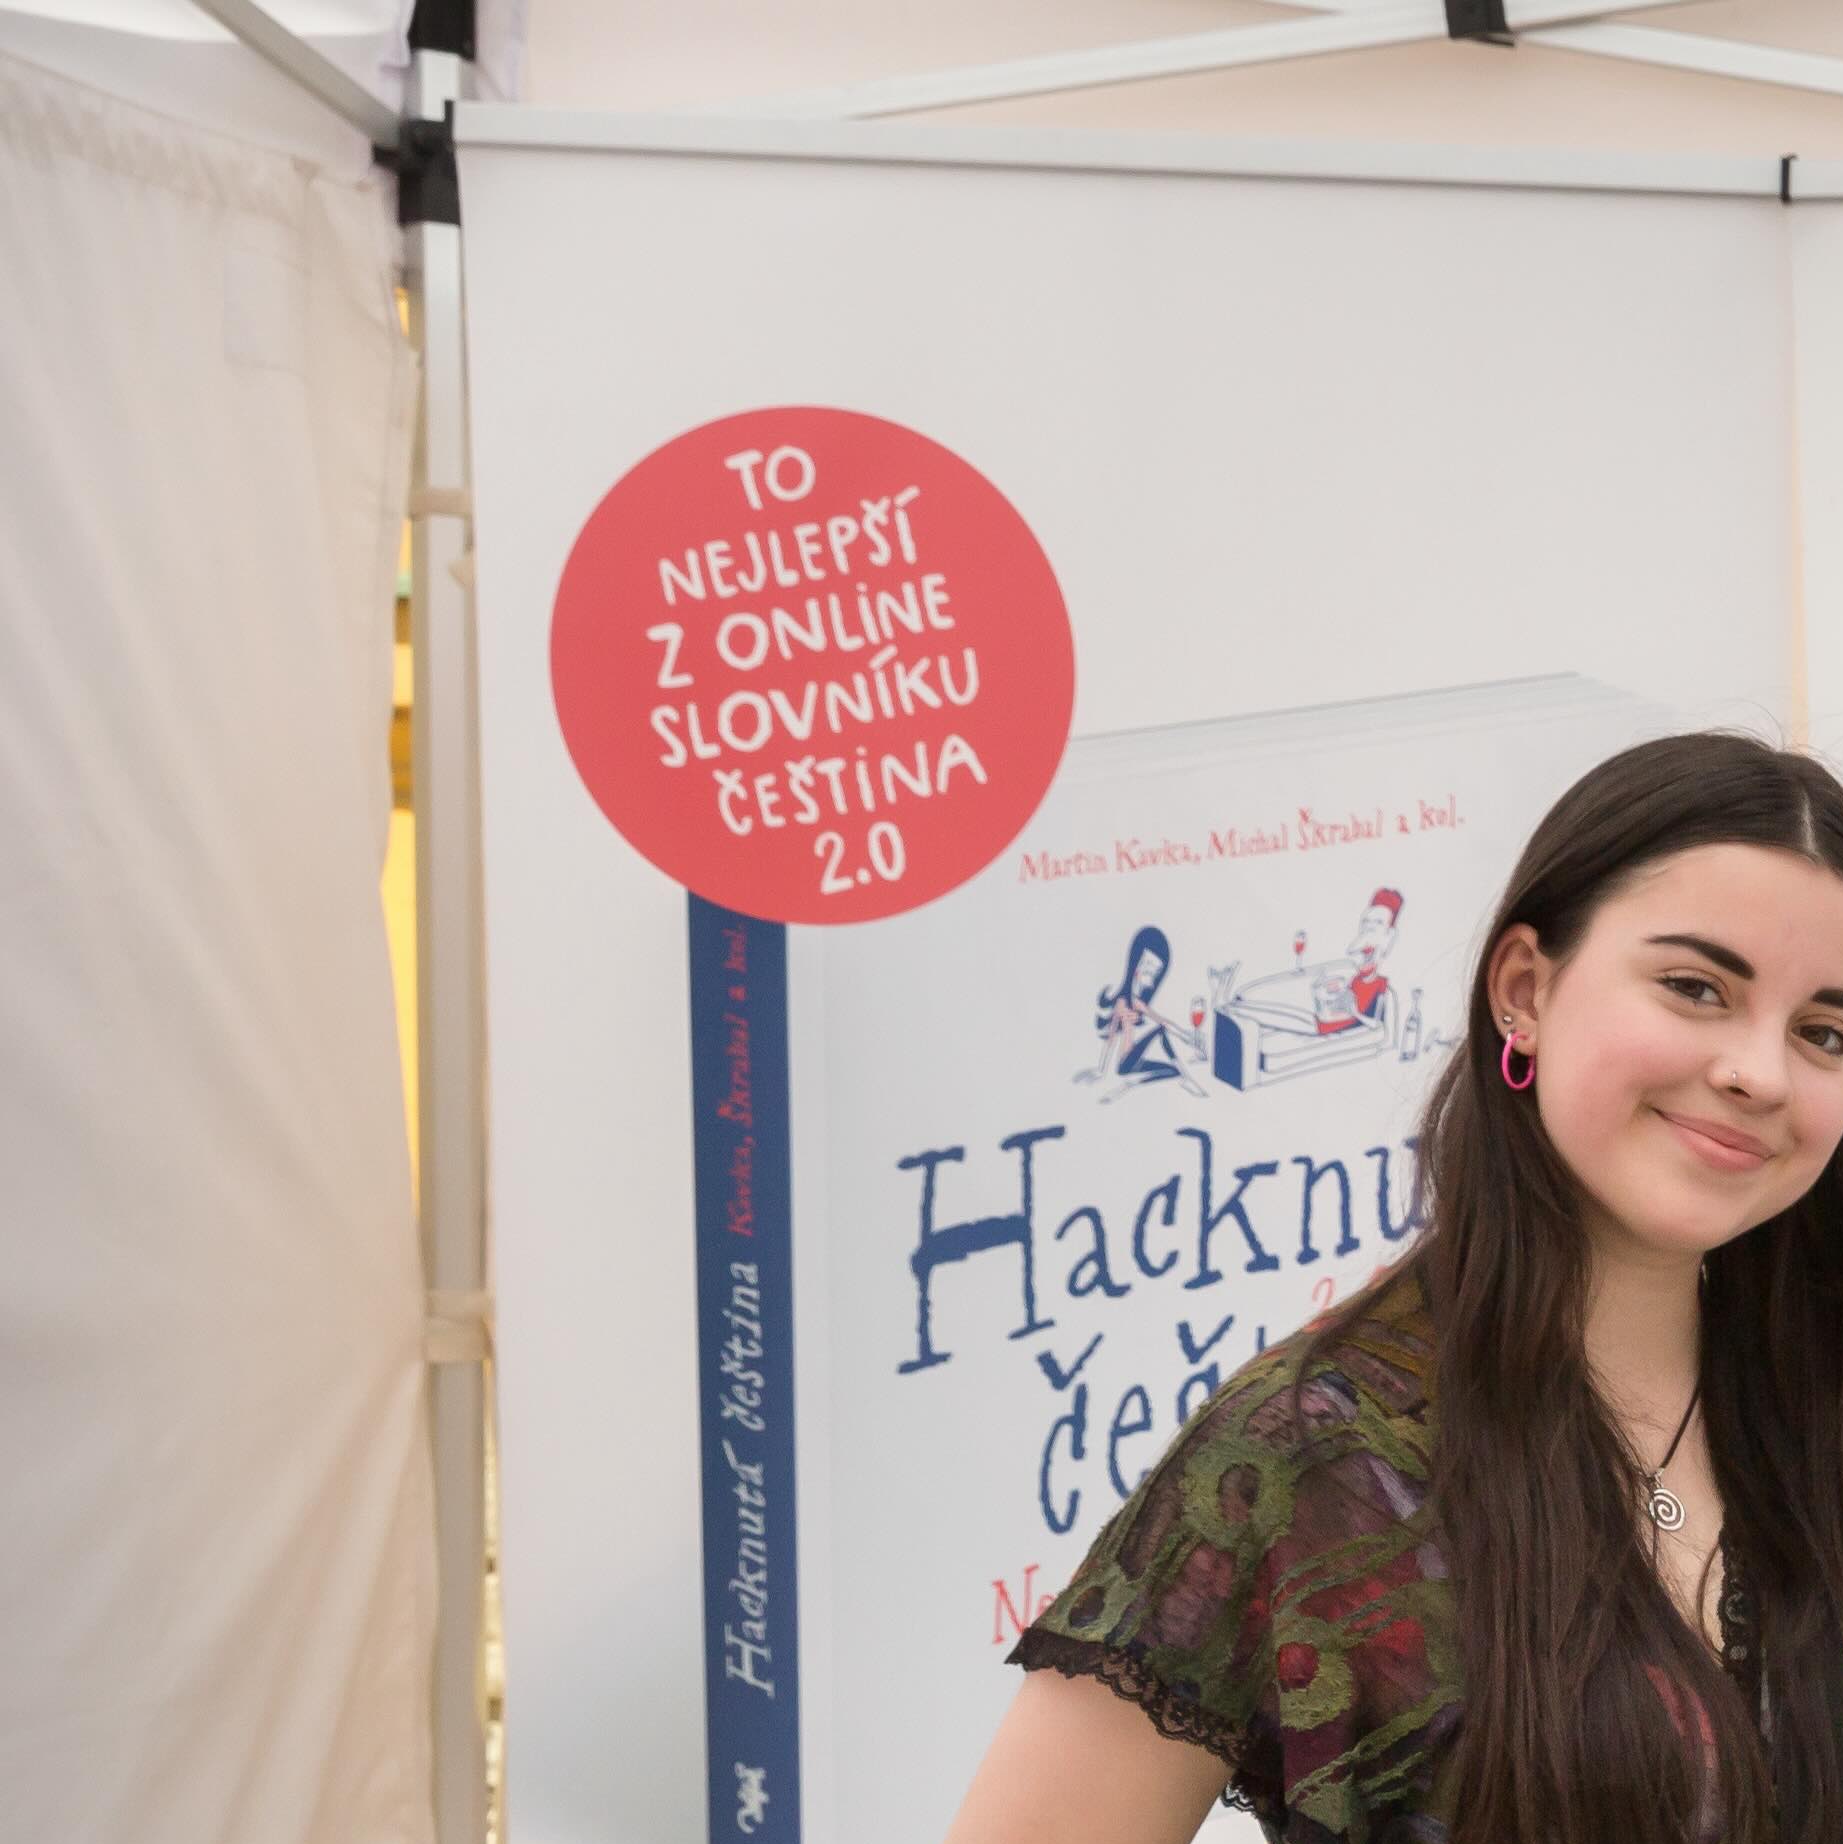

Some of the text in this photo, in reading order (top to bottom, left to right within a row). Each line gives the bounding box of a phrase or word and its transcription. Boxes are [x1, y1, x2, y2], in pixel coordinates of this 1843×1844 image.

[725, 445, 816, 510] TO
[659, 486, 920, 606] NEJLEPŠÍ
[646, 573, 955, 688] Z ONLINE
[650, 645, 980, 768] SLOVNÍKU
[714, 733, 988, 836] ČEŠTINA
[1019, 850, 1108, 883] Martin
[1207, 823, 1288, 861] Michal
[1396, 813, 1410, 835] a
[1418, 793, 1466, 831] kol.
[813, 820, 907, 895] 2.0
[897, 1126, 1426, 1374] Hacknu
